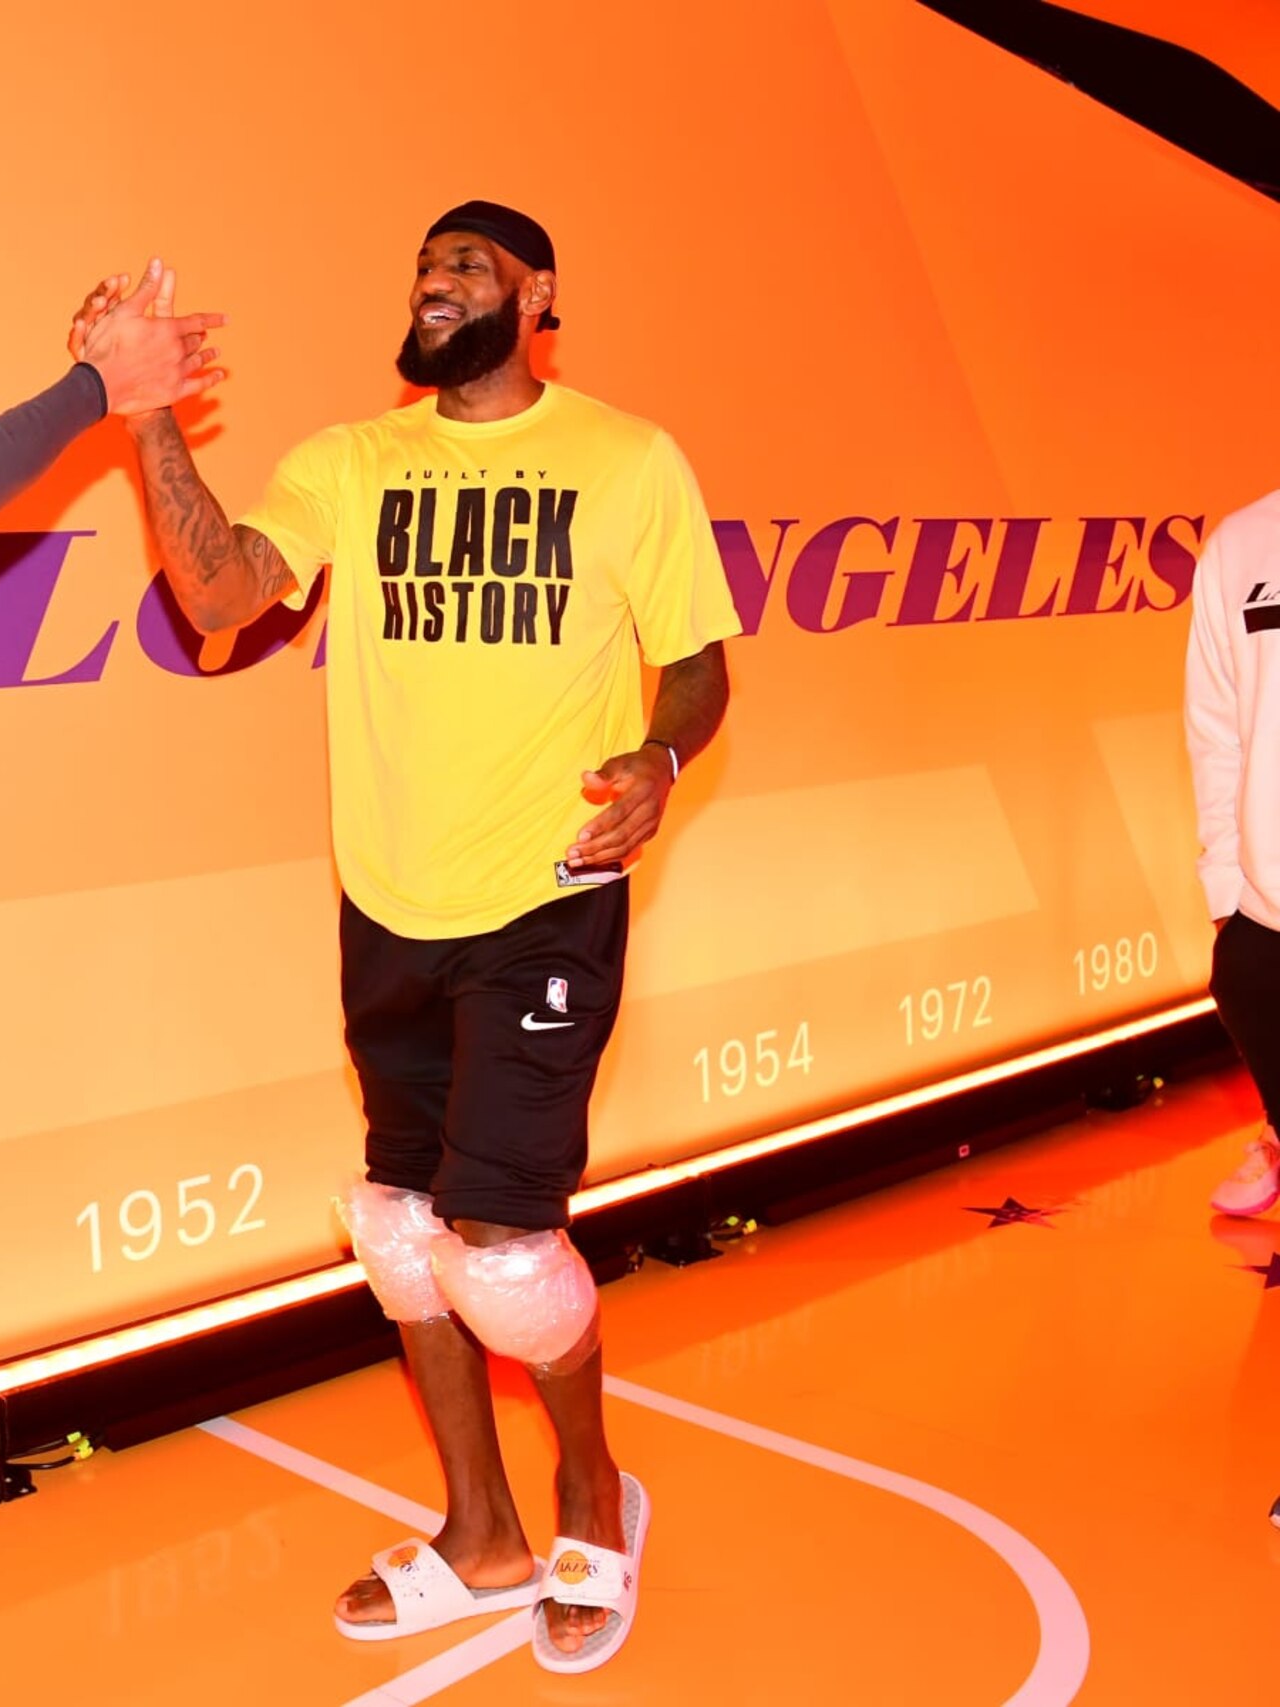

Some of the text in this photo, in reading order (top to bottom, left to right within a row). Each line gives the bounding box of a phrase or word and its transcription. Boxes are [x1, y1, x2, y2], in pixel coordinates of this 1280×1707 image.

[405, 469, 548, 481] BUILT BY
[376, 486, 579, 580] BLACK
[710, 513, 1205, 636] NGELES
[381, 581, 570, 646] HISTORY
[1073, 932, 1159, 996] 1980
[898, 975, 994, 1047] 1972
[693, 1021, 815, 1104] 1954
[76, 1163, 267, 1274] 1952
